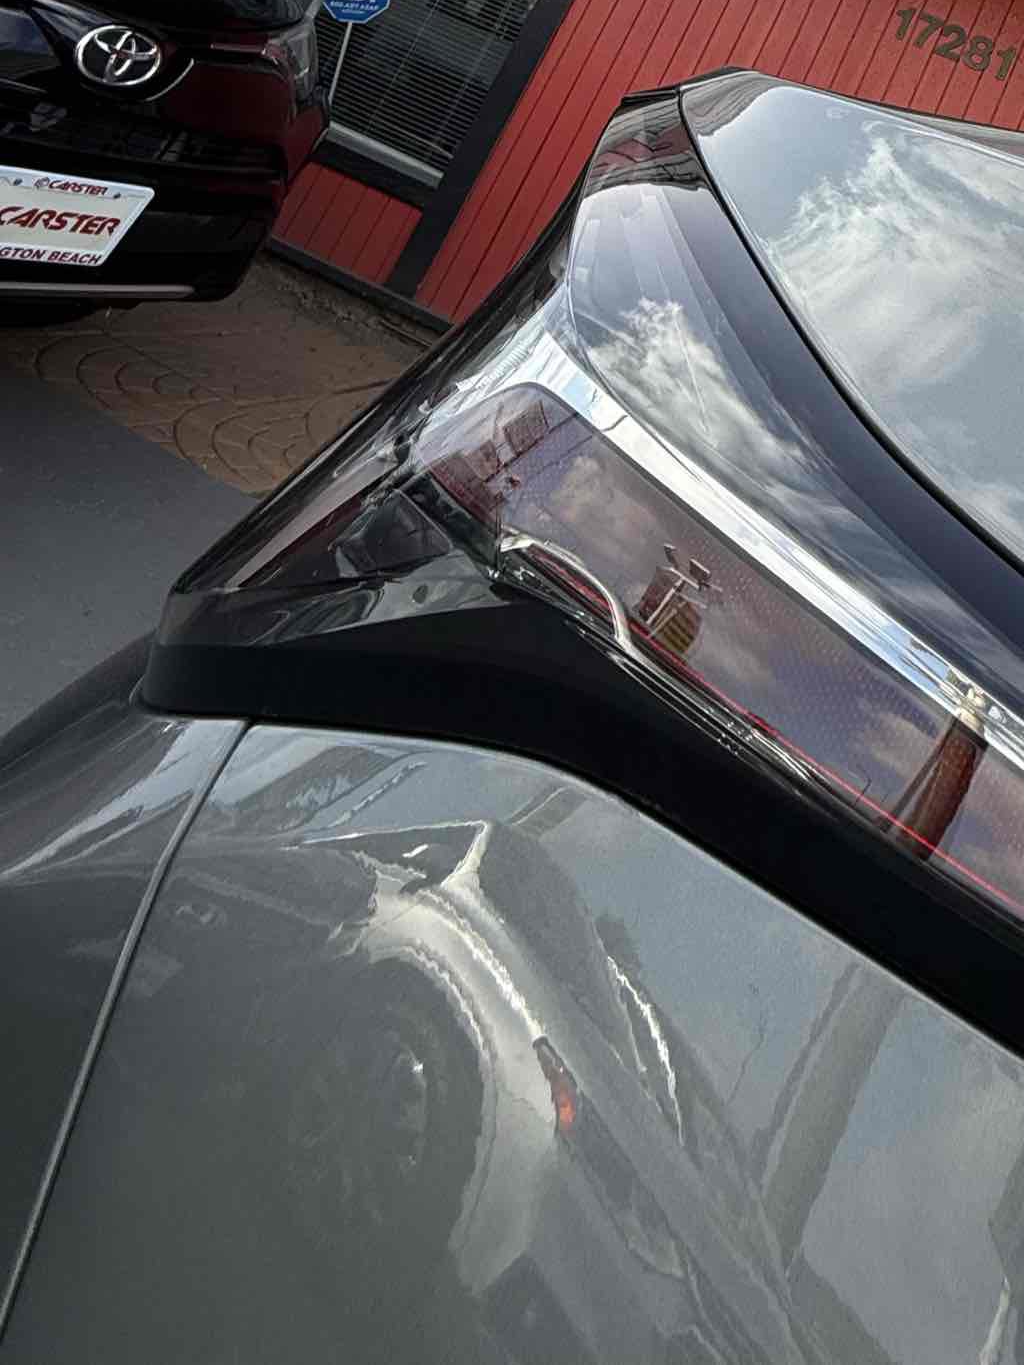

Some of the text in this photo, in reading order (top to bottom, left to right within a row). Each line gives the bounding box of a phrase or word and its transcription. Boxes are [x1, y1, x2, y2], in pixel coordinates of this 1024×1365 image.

[896, 9, 1017, 82] 17281
[48, 179, 109, 196] CARSTER
[0, 206, 121, 237] CARSTER
[0, 245, 102, 266] GTON BEACH
